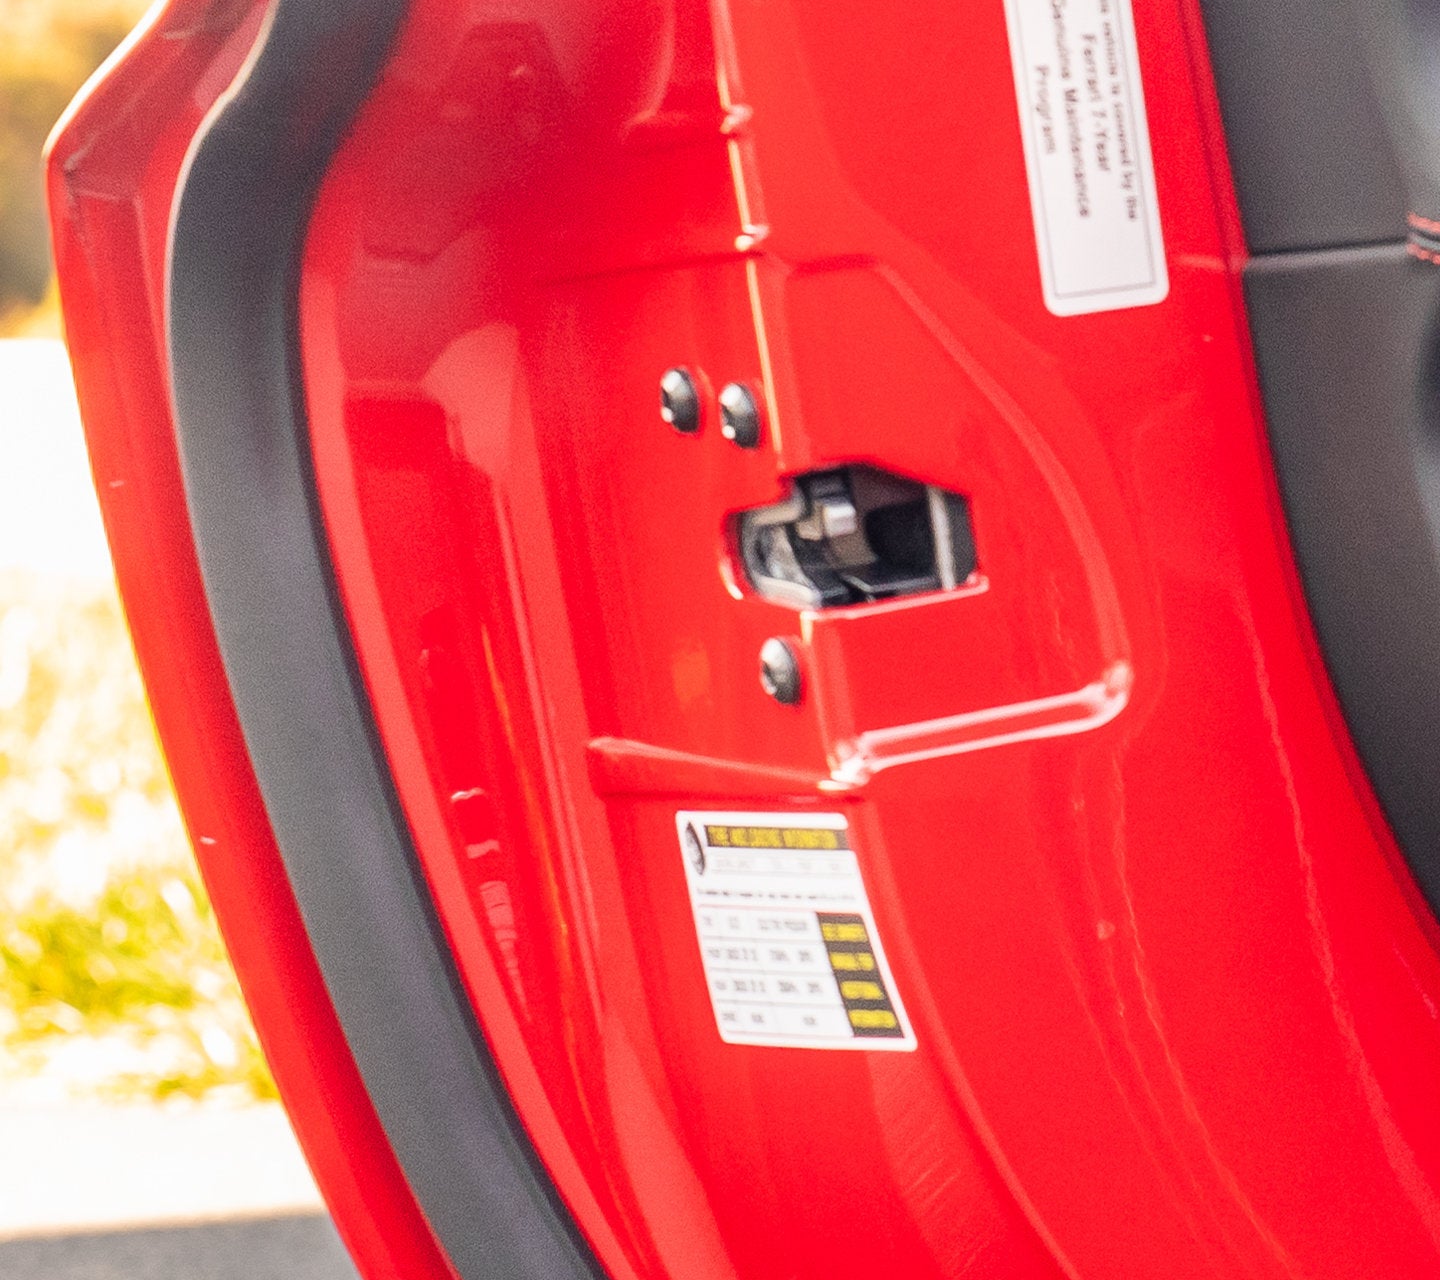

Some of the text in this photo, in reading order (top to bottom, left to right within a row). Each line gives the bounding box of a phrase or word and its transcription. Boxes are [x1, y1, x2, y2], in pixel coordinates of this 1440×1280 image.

[1034, 65, 1057, 154] Program
[1082, 33, 1102, 102] Ferrari
[1064, 88, 1092, 217] Maintenance
